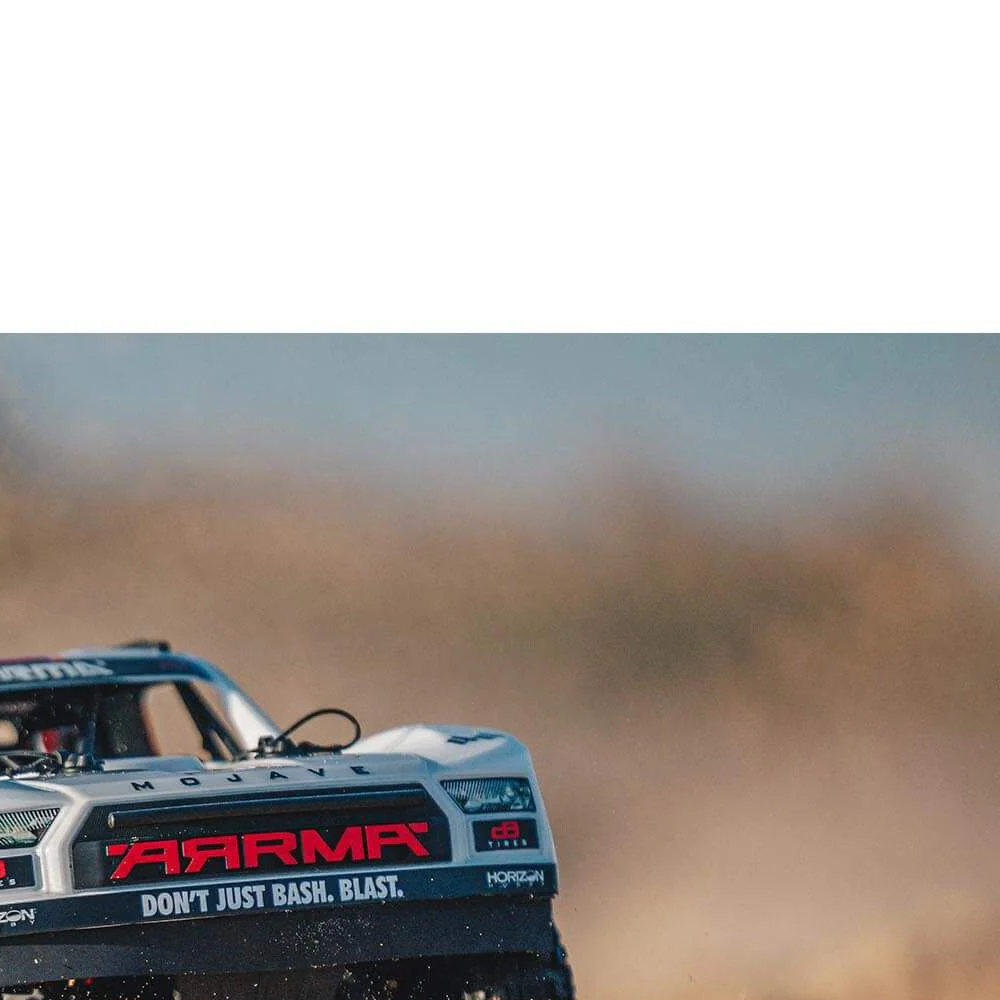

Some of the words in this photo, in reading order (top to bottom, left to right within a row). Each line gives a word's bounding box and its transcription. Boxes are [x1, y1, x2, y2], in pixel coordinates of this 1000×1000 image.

[131, 765, 370, 791] MOJAVE
[106, 822, 430, 880] ARRMA
[487, 870, 545, 883] HORIZON
[141, 889, 210, 917] DON'T
[216, 885, 265, 911] JUST
[271, 880, 334, 906] BASH.
[339, 875, 404, 900] BLAST.
